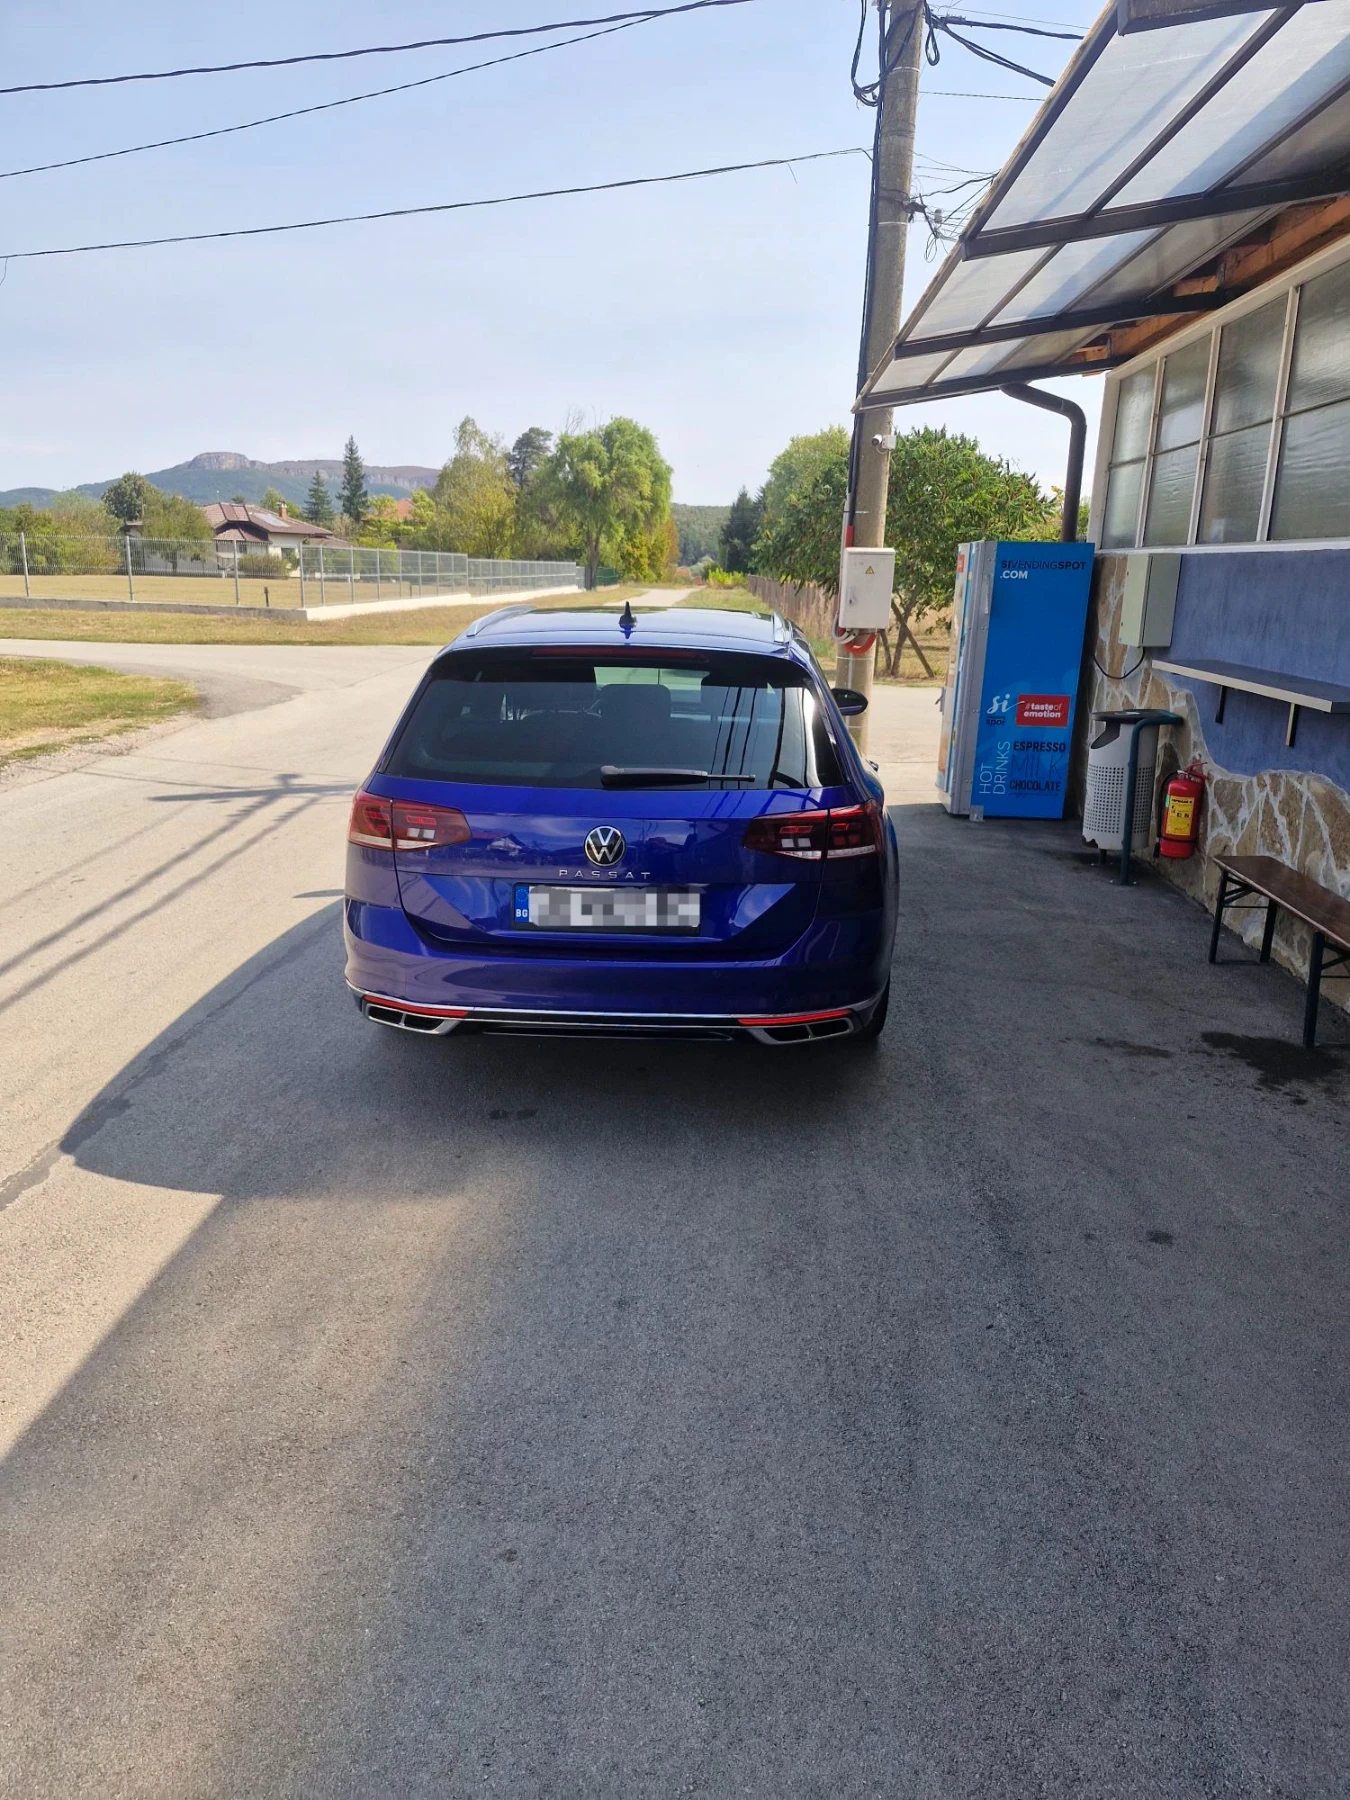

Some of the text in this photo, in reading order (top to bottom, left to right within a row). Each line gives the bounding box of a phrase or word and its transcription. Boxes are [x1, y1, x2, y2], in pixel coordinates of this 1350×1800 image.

[1001, 560, 1087, 570] SIVENDINGSPOT
[1000, 570, 1028, 579] .COM
[1023, 710, 1061, 718] emotion
[1013, 741, 1066, 753] ESPRESSO
[992, 741, 1011, 795] DRINKS
[1010, 753, 1064, 780] MILK
[979, 762, 993, 794] HOT
[1009, 779, 1062, 792] CHOCOLATE
[558, 869, 651, 879] PASSAT
[515, 908, 528, 918] BG
